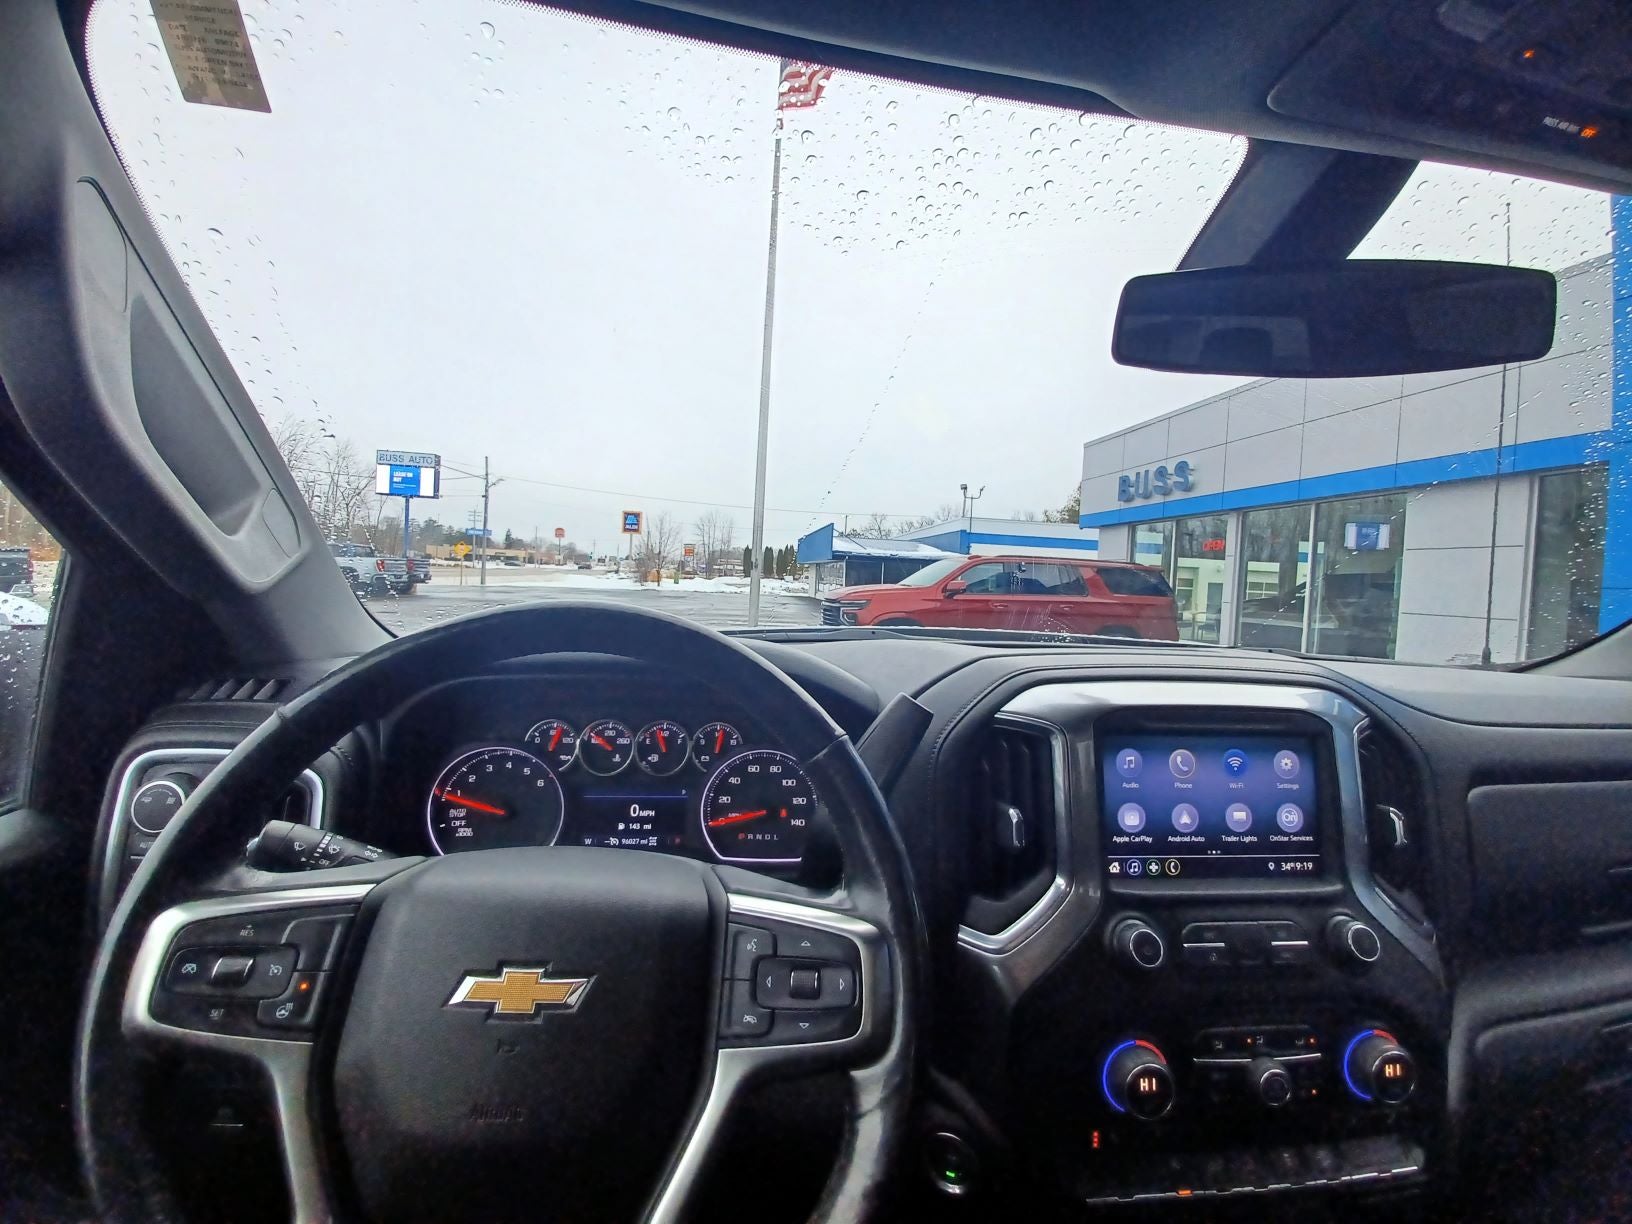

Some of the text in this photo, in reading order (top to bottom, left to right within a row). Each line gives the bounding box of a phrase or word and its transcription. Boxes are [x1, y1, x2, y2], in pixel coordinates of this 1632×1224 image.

[379, 453, 433, 465] BUSS AUTO
[1117, 460, 1193, 503] BUSS
[486, 764, 493, 772] 3
[505, 761, 513, 769] 4
[748, 765, 760, 773] 60
[769, 765, 782, 773] 80
[523, 767, 531, 775] 5
[468, 775, 476, 783] 2
[537, 779, 544, 787] 6
[1276, 782, 1299, 790] Settings
[457, 789, 461, 797] 1
[718, 796, 731, 804] 20
[630, 804, 639, 817] 0
[1240, 835, 1258, 843] Lights
[1296, 862, 1313, 870] 9:19
[240, 929, 254, 937] RES
[209, 1009, 225, 1018] SET
[1385, 1063, 1401, 1077] HI
[1140, 1078, 1157, 1092] HI
